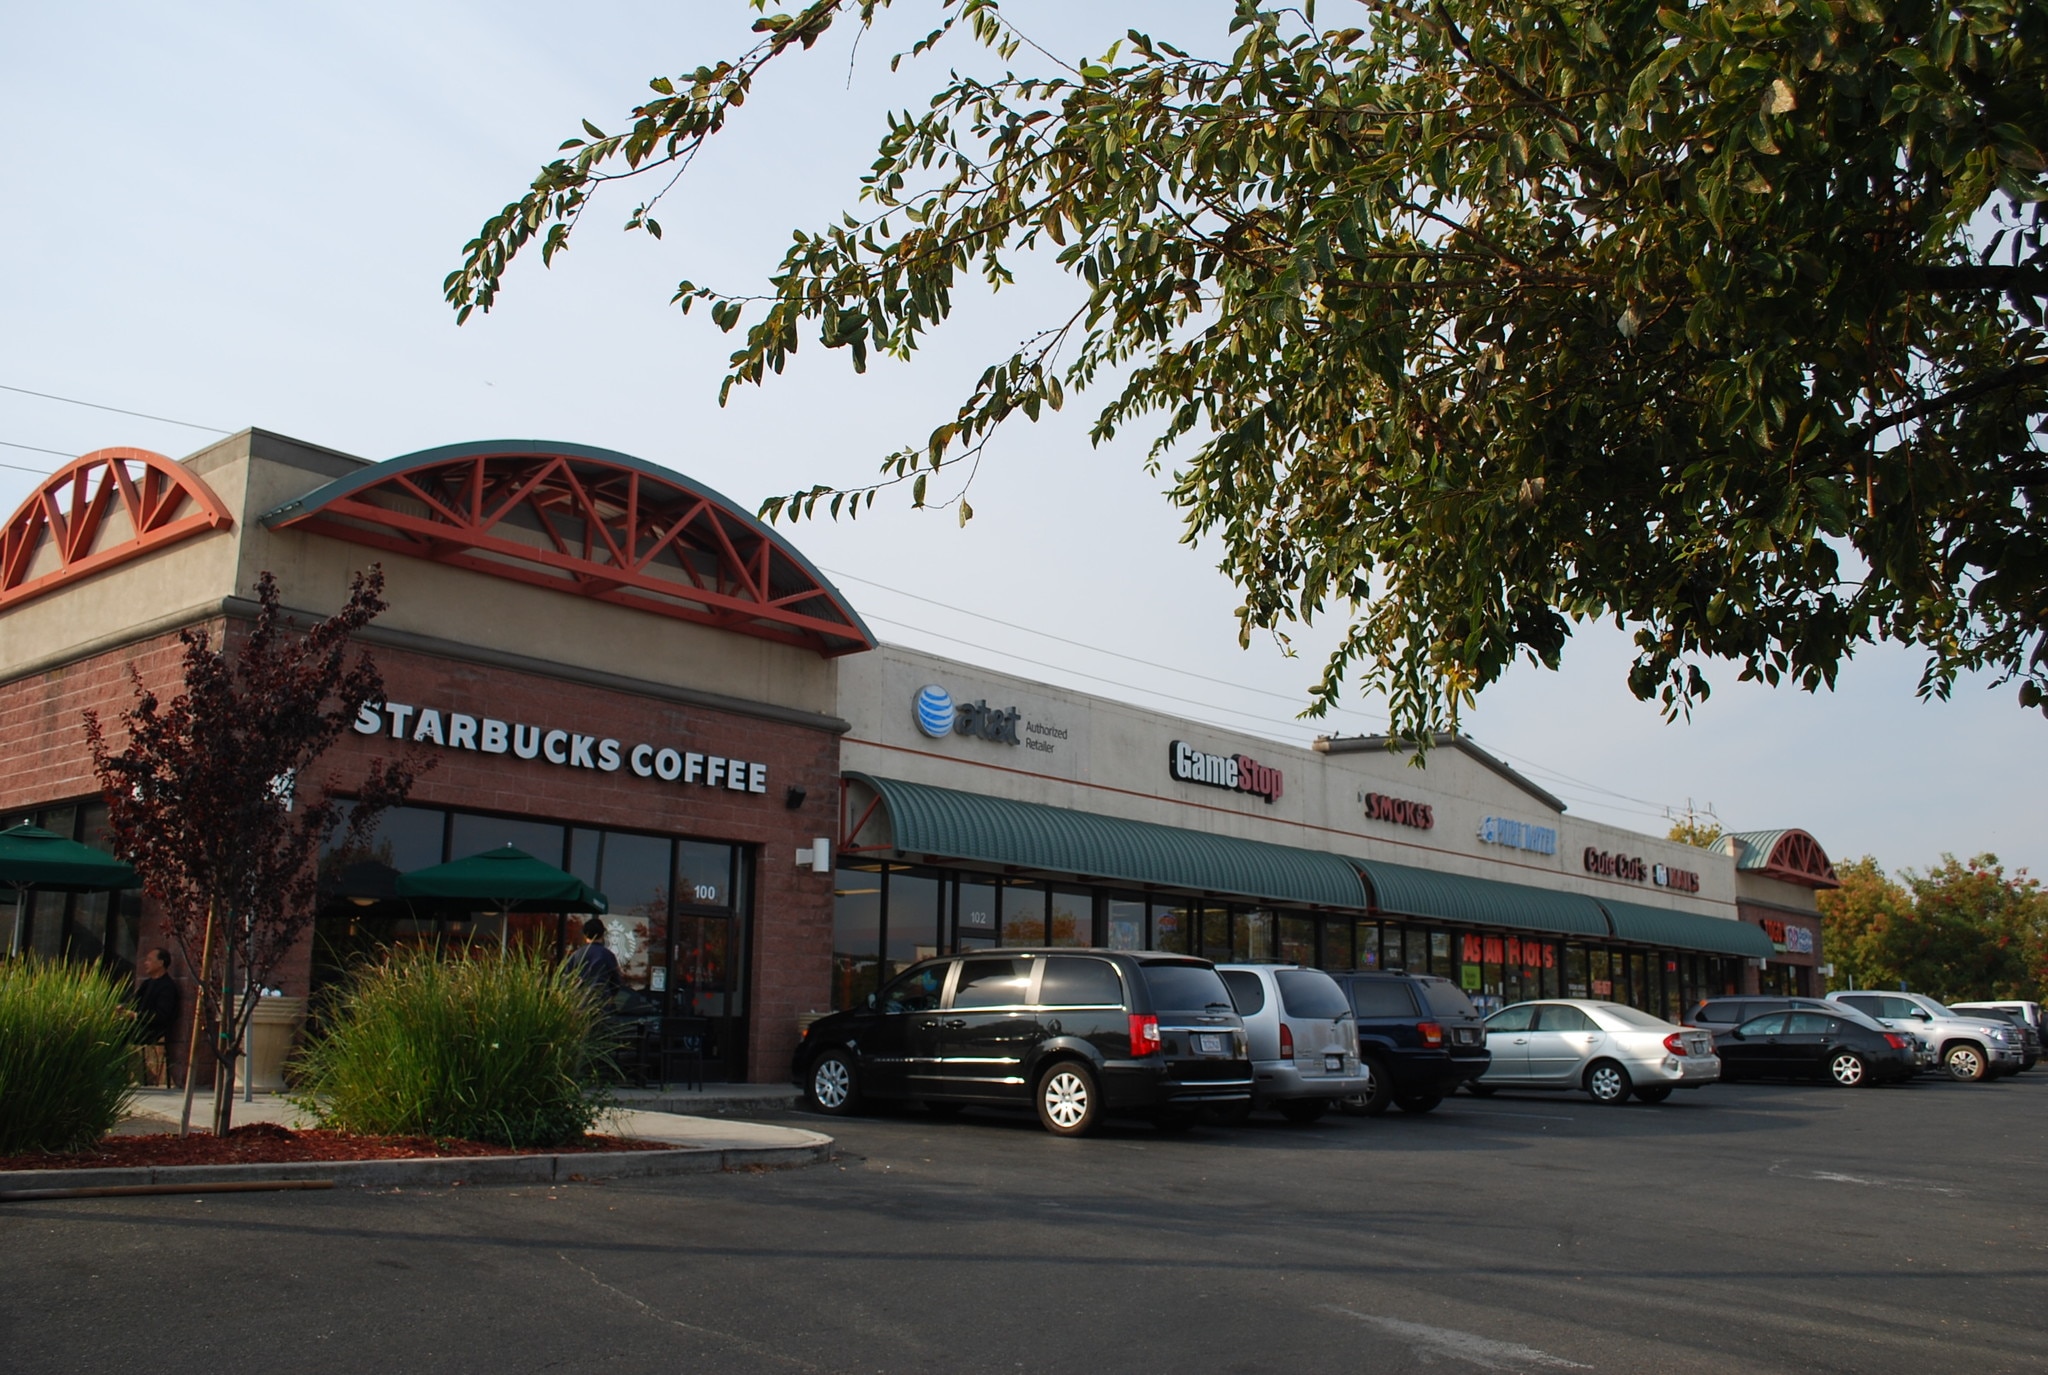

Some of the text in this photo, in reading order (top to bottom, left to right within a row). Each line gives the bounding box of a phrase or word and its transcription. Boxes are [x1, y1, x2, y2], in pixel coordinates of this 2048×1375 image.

[953, 699, 1021, 747] at&t
[1025, 721, 1068, 740] Authorized
[353, 700, 767, 794] STARBUCKS COFFEE
[1025, 737, 1055, 753] Retailer
[1171, 741, 1283, 802] GameStop
[1365, 793, 1435, 829] SMOKES
[694, 885, 716, 900] 100
[971, 911, 986, 924] 102
[1462, 933, 1504, 964] ASAN
